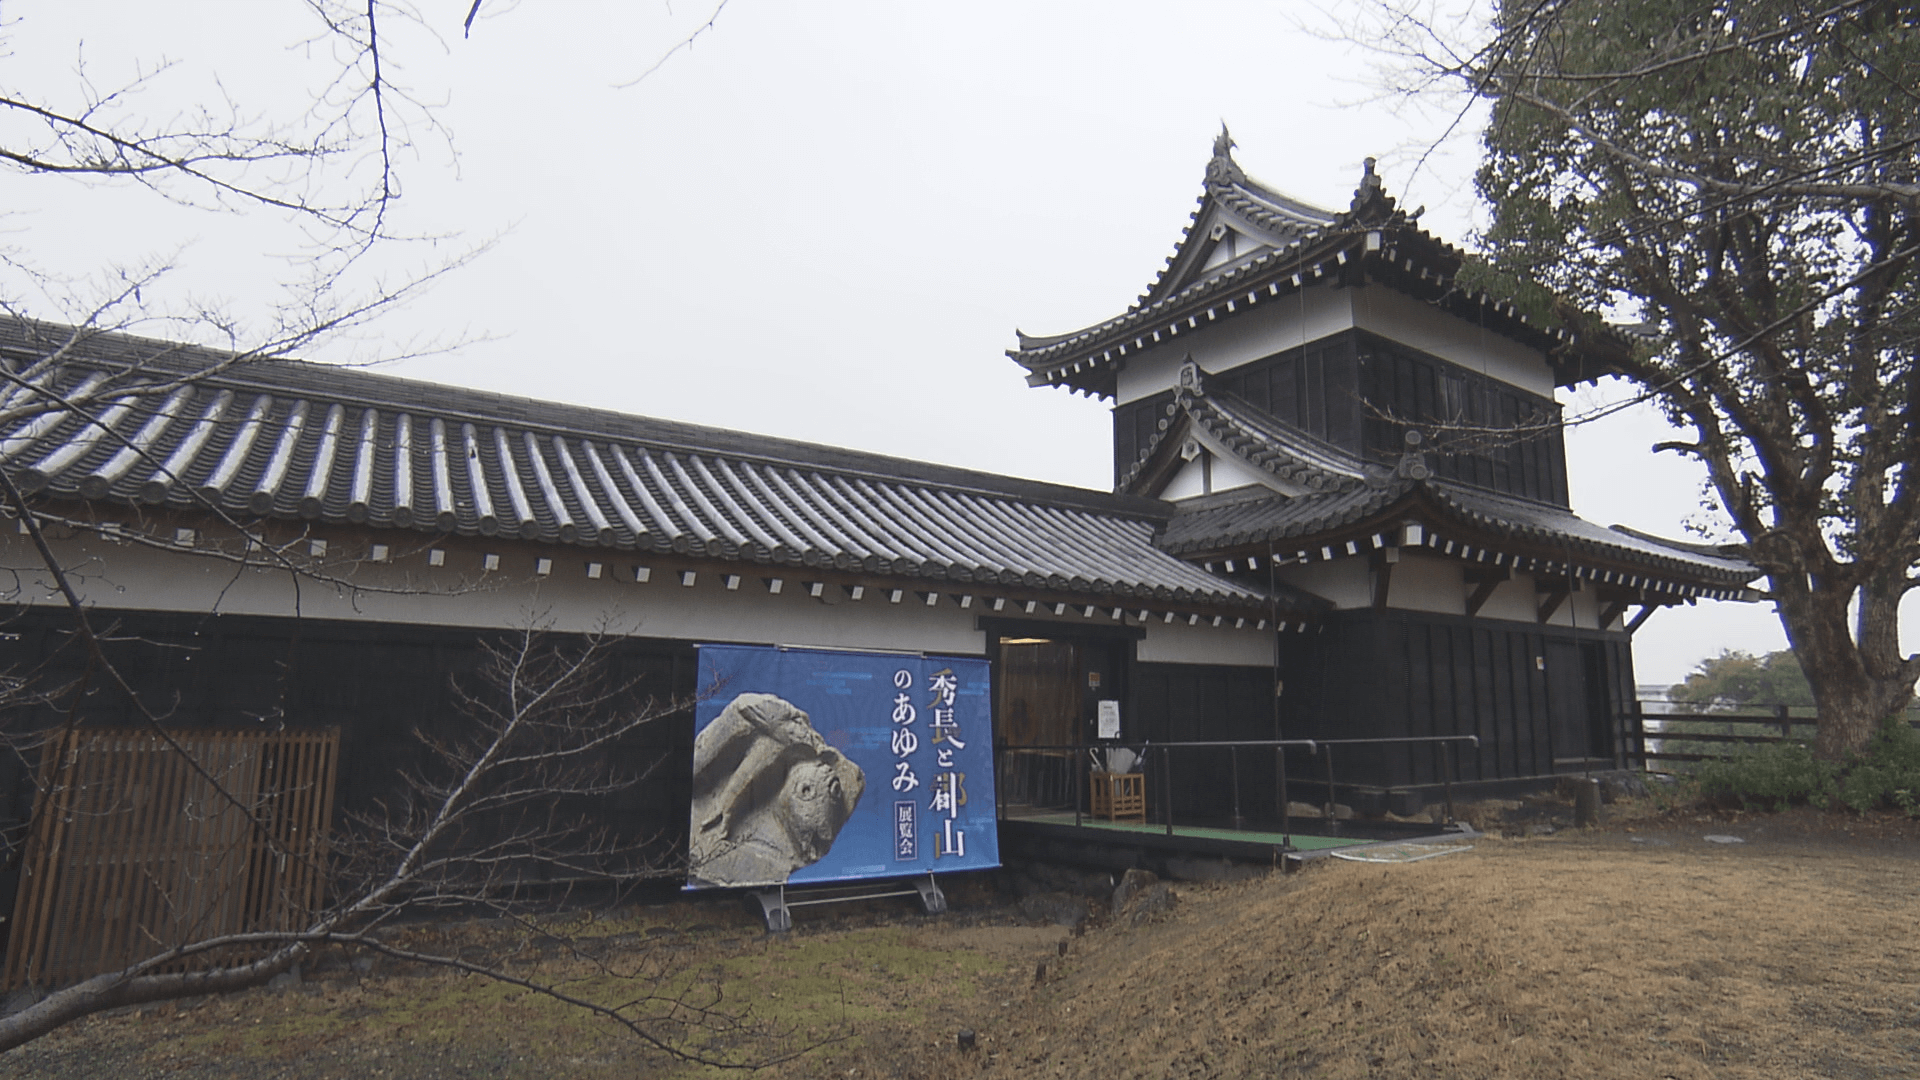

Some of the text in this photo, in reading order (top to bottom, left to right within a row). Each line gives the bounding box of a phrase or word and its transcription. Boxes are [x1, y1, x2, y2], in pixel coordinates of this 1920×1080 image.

[891, 669, 919, 792] のあゆみ
[898, 806, 913, 856] 展覧会
